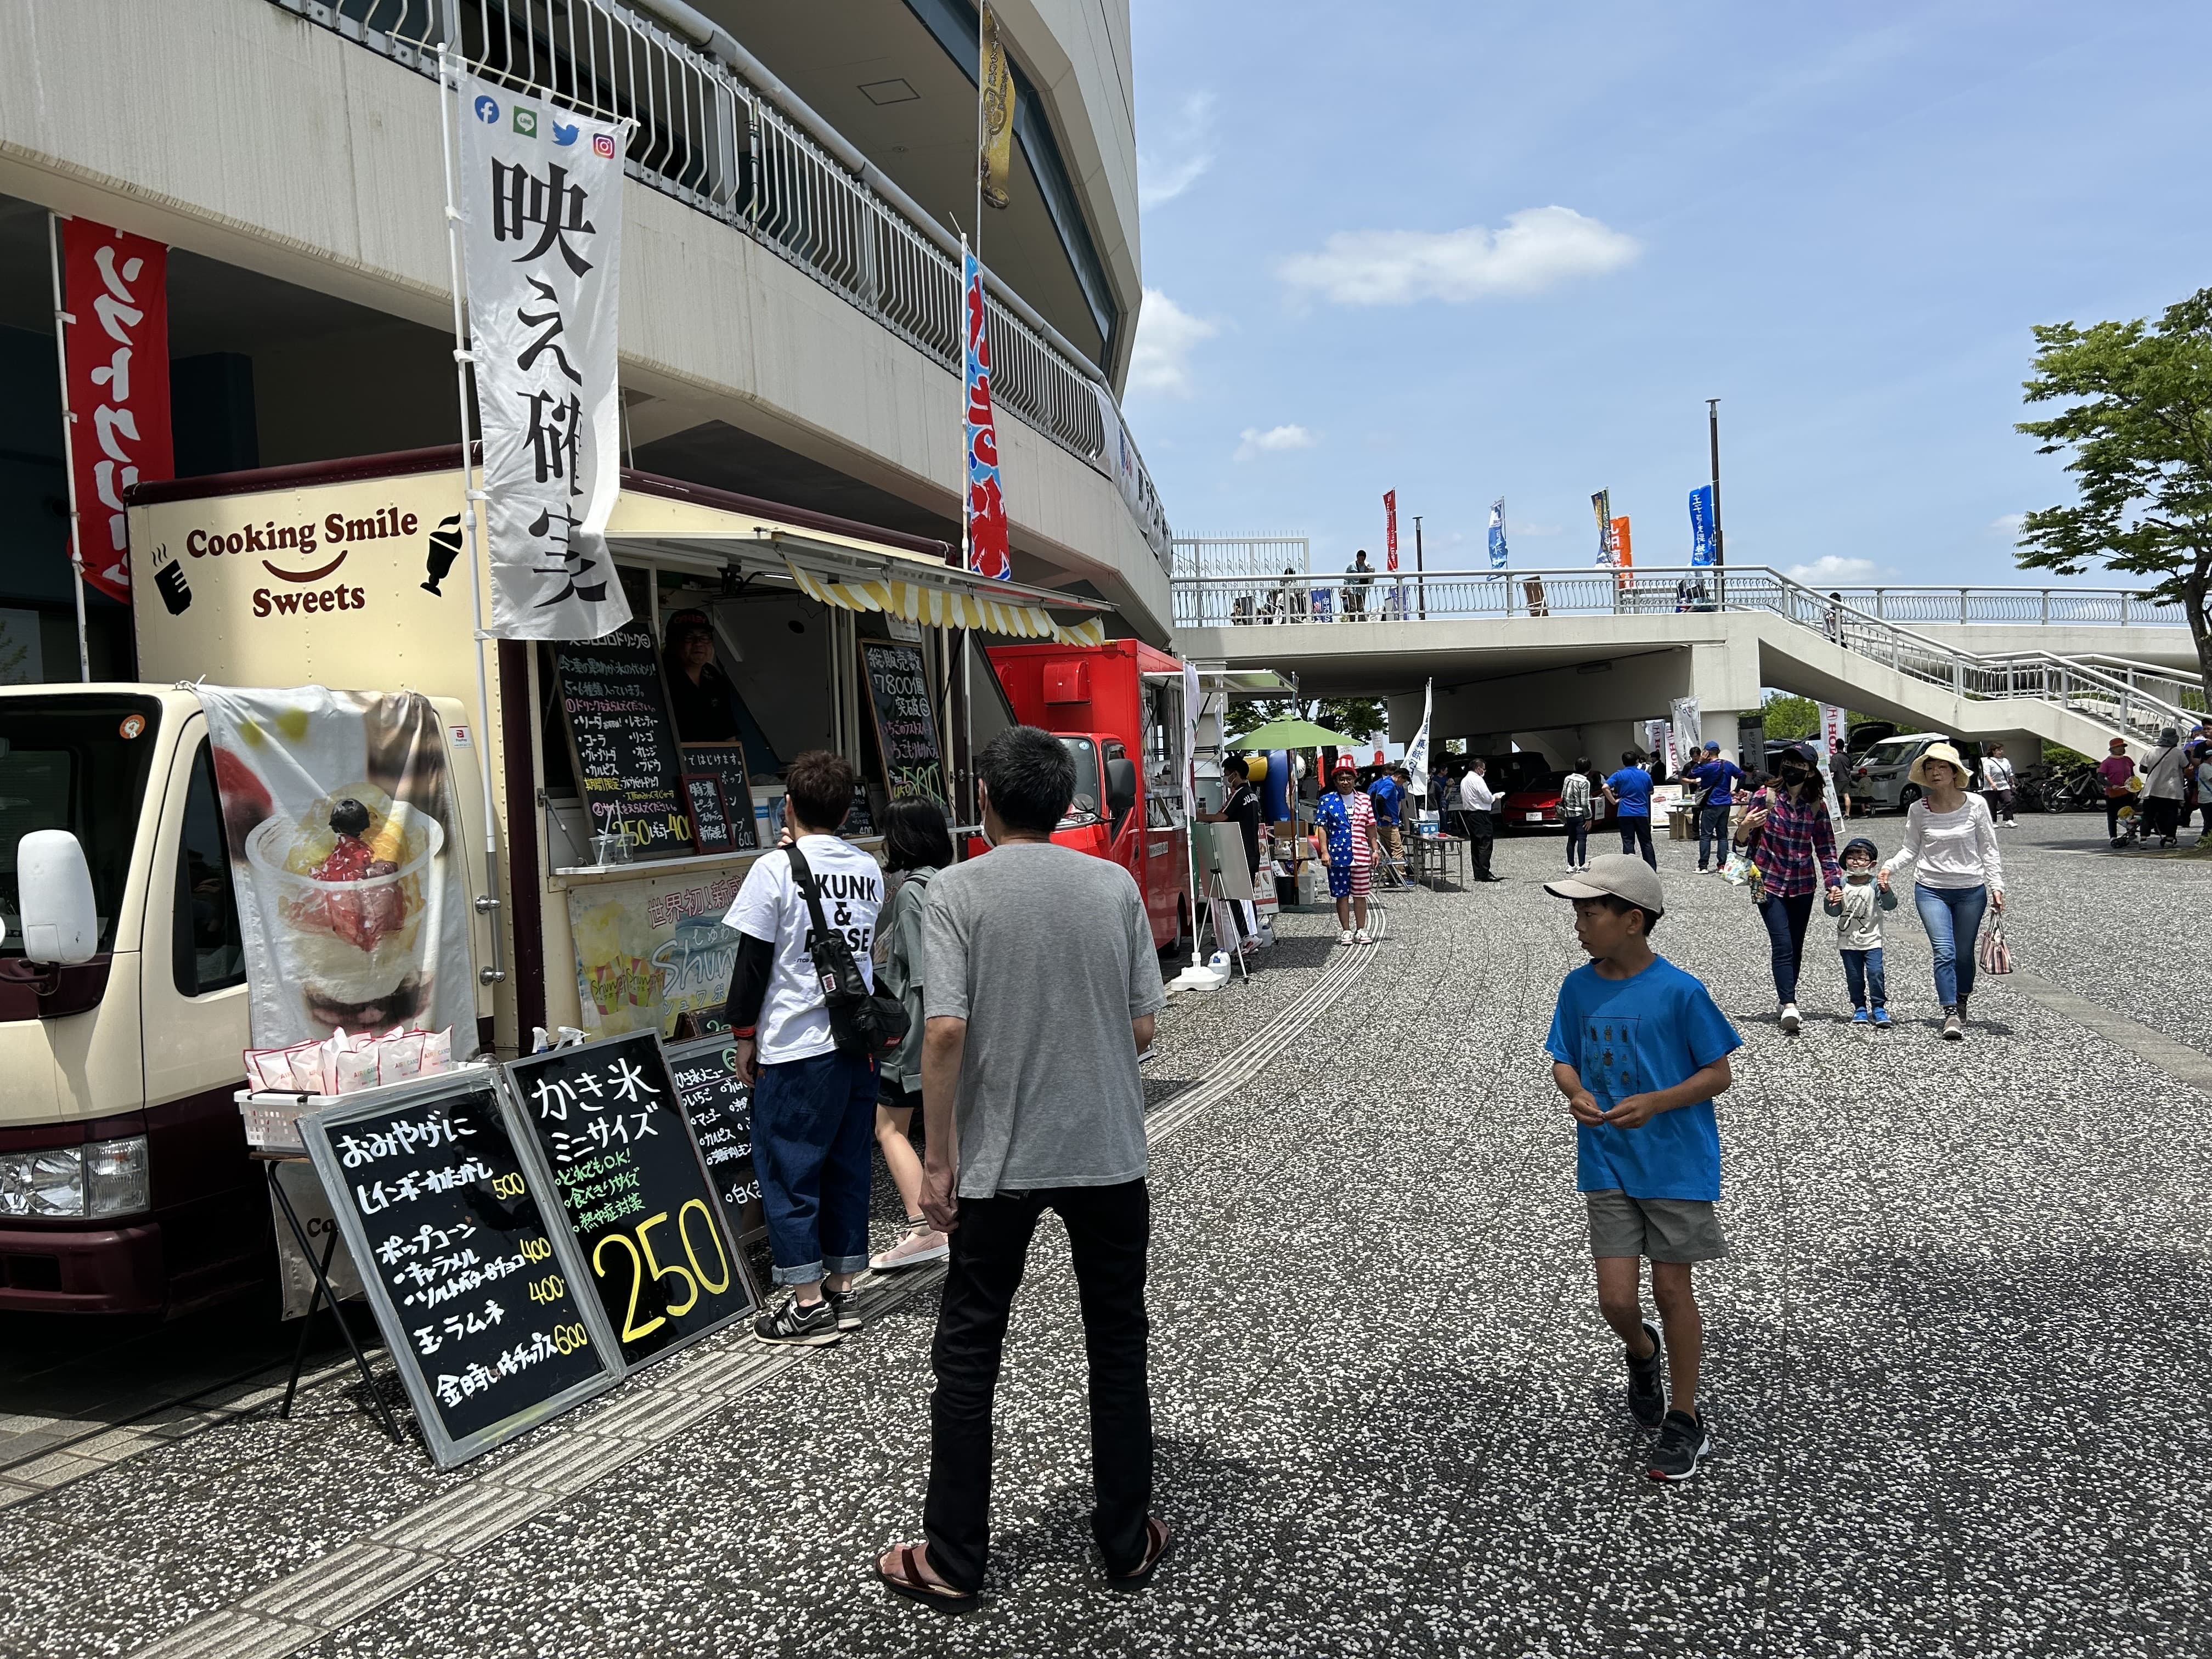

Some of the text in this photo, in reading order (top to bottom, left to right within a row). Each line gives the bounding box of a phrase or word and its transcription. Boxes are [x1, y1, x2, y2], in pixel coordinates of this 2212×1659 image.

[519, 116, 532, 126] LINE
[187, 506, 418, 558] Cooking Smile
[252, 583, 365, 618] Sweets
[867, 647, 923, 672] 総販売数
[873, 674, 924, 695] 7800個
[895, 695, 922, 717] 突破
[583, 734, 606, 747] コーラ
[632, 729, 654, 743] リンゴ
[584, 776, 622, 791] 期間限定
[588, 763, 619, 777] カルピス
[647, 872, 747, 929] 世界初!新感
[834, 901, 852, 926] &
[531, 1057, 661, 1121] かき氷
[685, 1087, 713, 1107] いちご
[551, 1101, 658, 1163] ミニサイズ
[695, 1108, 721, 1126] マンゴー
[335, 1110, 477, 1169] おみやげに
[704, 1128, 736, 1147] カルピス
[356, 1157, 526, 1215] レインボーわたがし 500
[569, 1166, 640, 1209] 食べきりサイズ
[579, 1193, 646, 1234] 熱中症対策
[375, 1223, 477, 1265] ポップコーン
[521, 1237, 552, 1265] 400
[404, 1248, 481, 1288] キャラメル
[592, 1198, 730, 1343] 250
[528, 1274, 563, 1306] 400
[435, 1322, 588, 1408] 金時いもチップス 600
